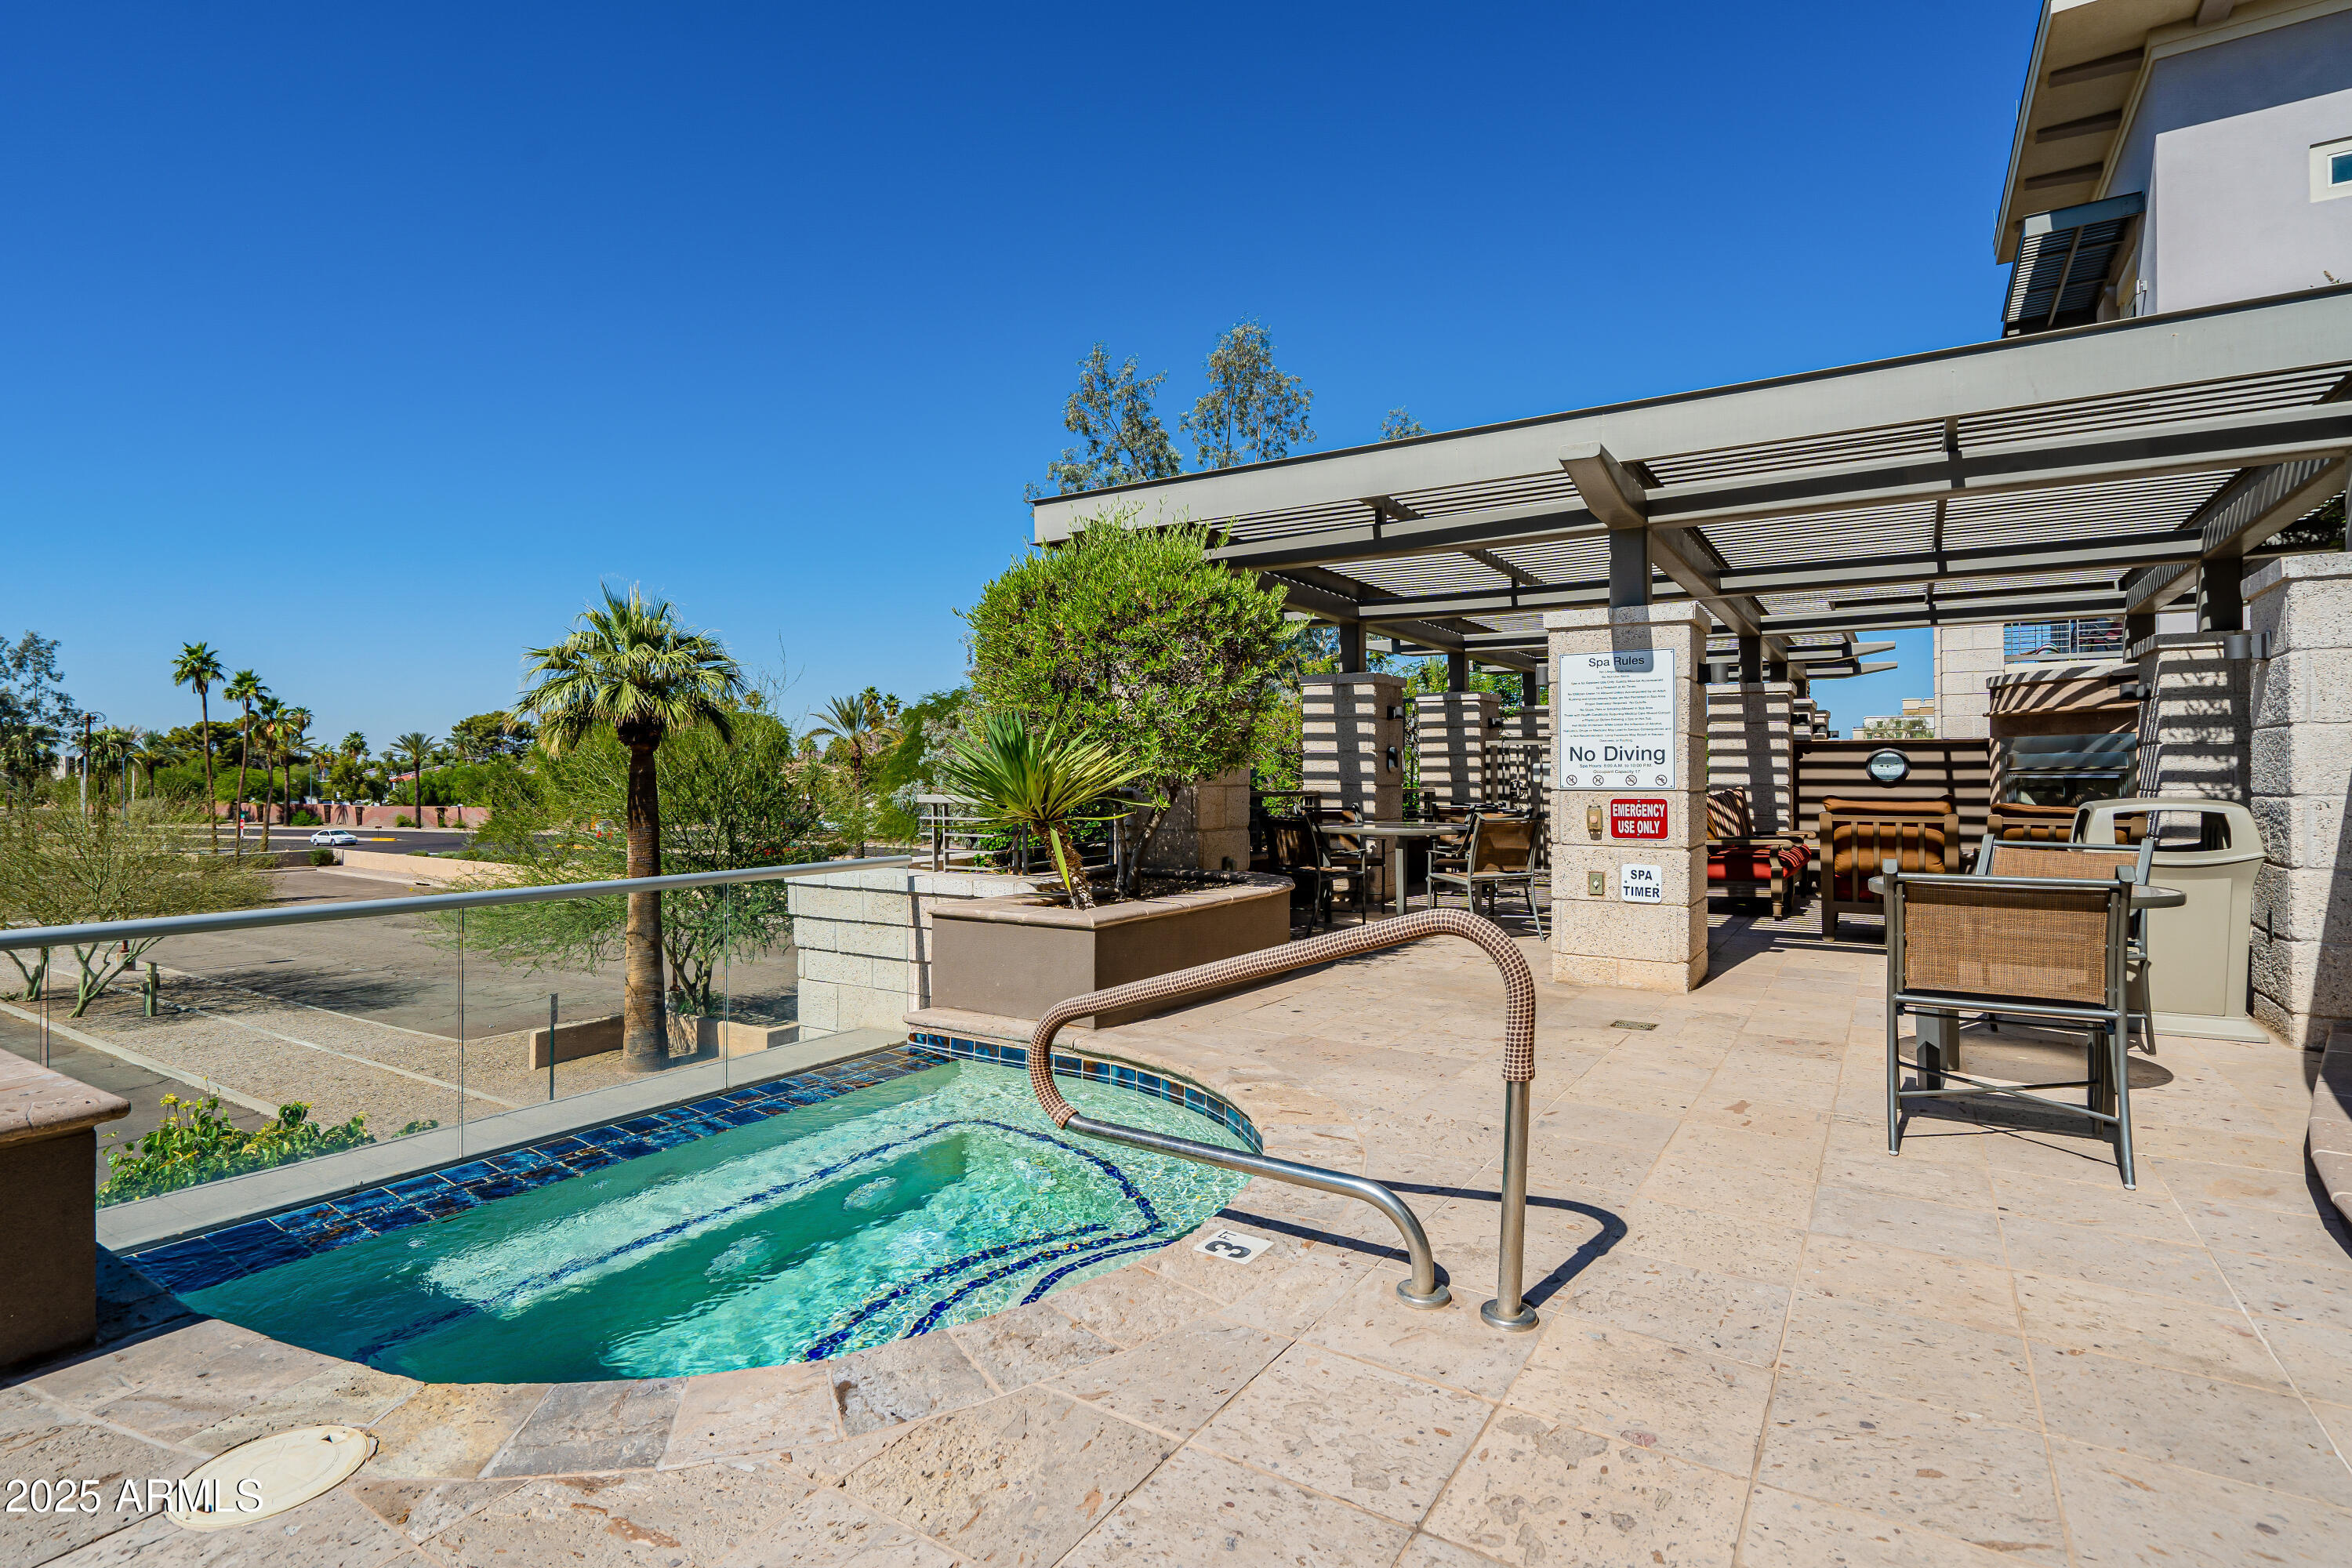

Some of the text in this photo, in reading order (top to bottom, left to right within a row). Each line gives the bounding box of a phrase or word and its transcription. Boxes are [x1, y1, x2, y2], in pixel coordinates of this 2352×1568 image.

[1589, 656, 1644, 668] Spa Rules
[1570, 746, 1665, 764] No Diving
[1613, 804, 1665, 817] EMERGENCY
[1618, 821, 1660, 834] USE ONLY
[1631, 870, 1652, 880] SPA
[1624, 886, 1660, 898] TIMER
[1205, 1231, 1251, 1258] 3 FT
